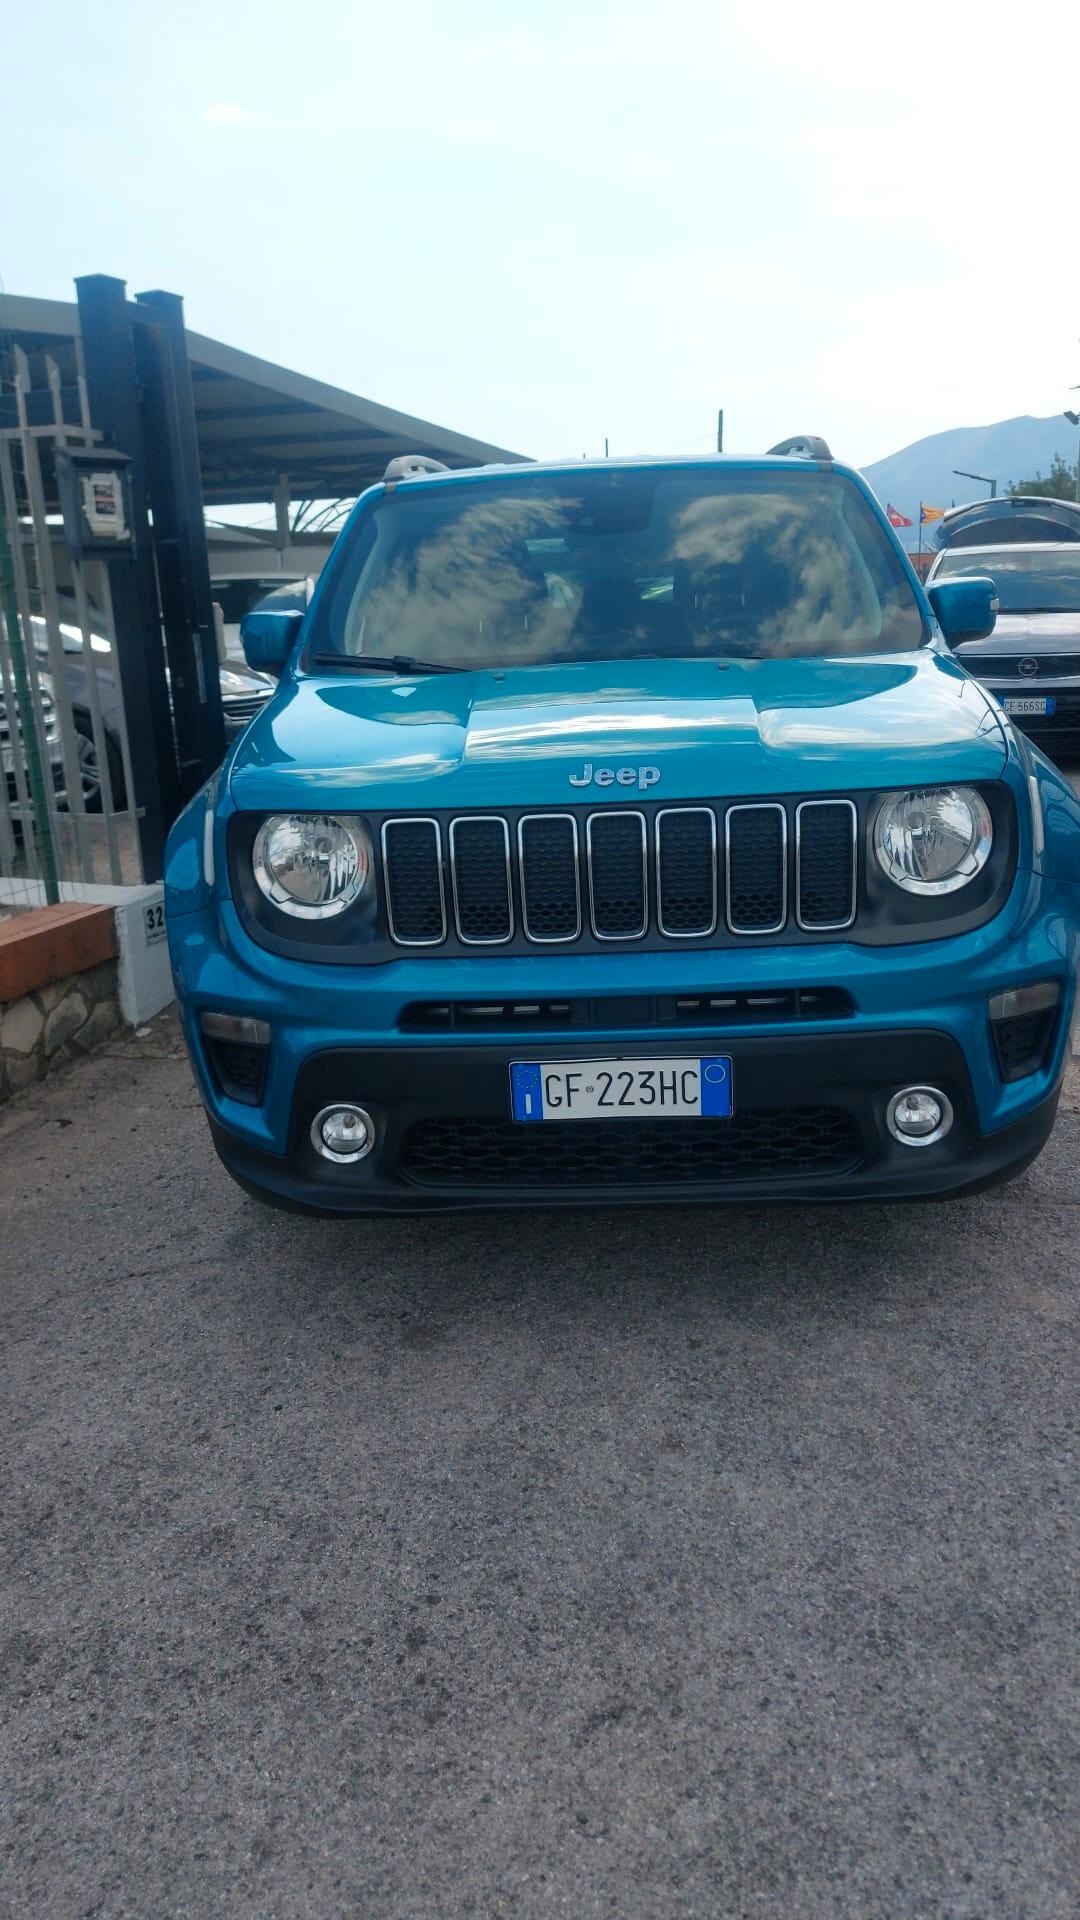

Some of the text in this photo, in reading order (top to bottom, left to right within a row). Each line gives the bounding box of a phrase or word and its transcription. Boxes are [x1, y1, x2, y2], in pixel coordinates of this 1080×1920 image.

[568, 763, 661, 790] Jeep
[147, 906, 164, 930] 32
[545, 1070, 699, 1108] GF 223HC
